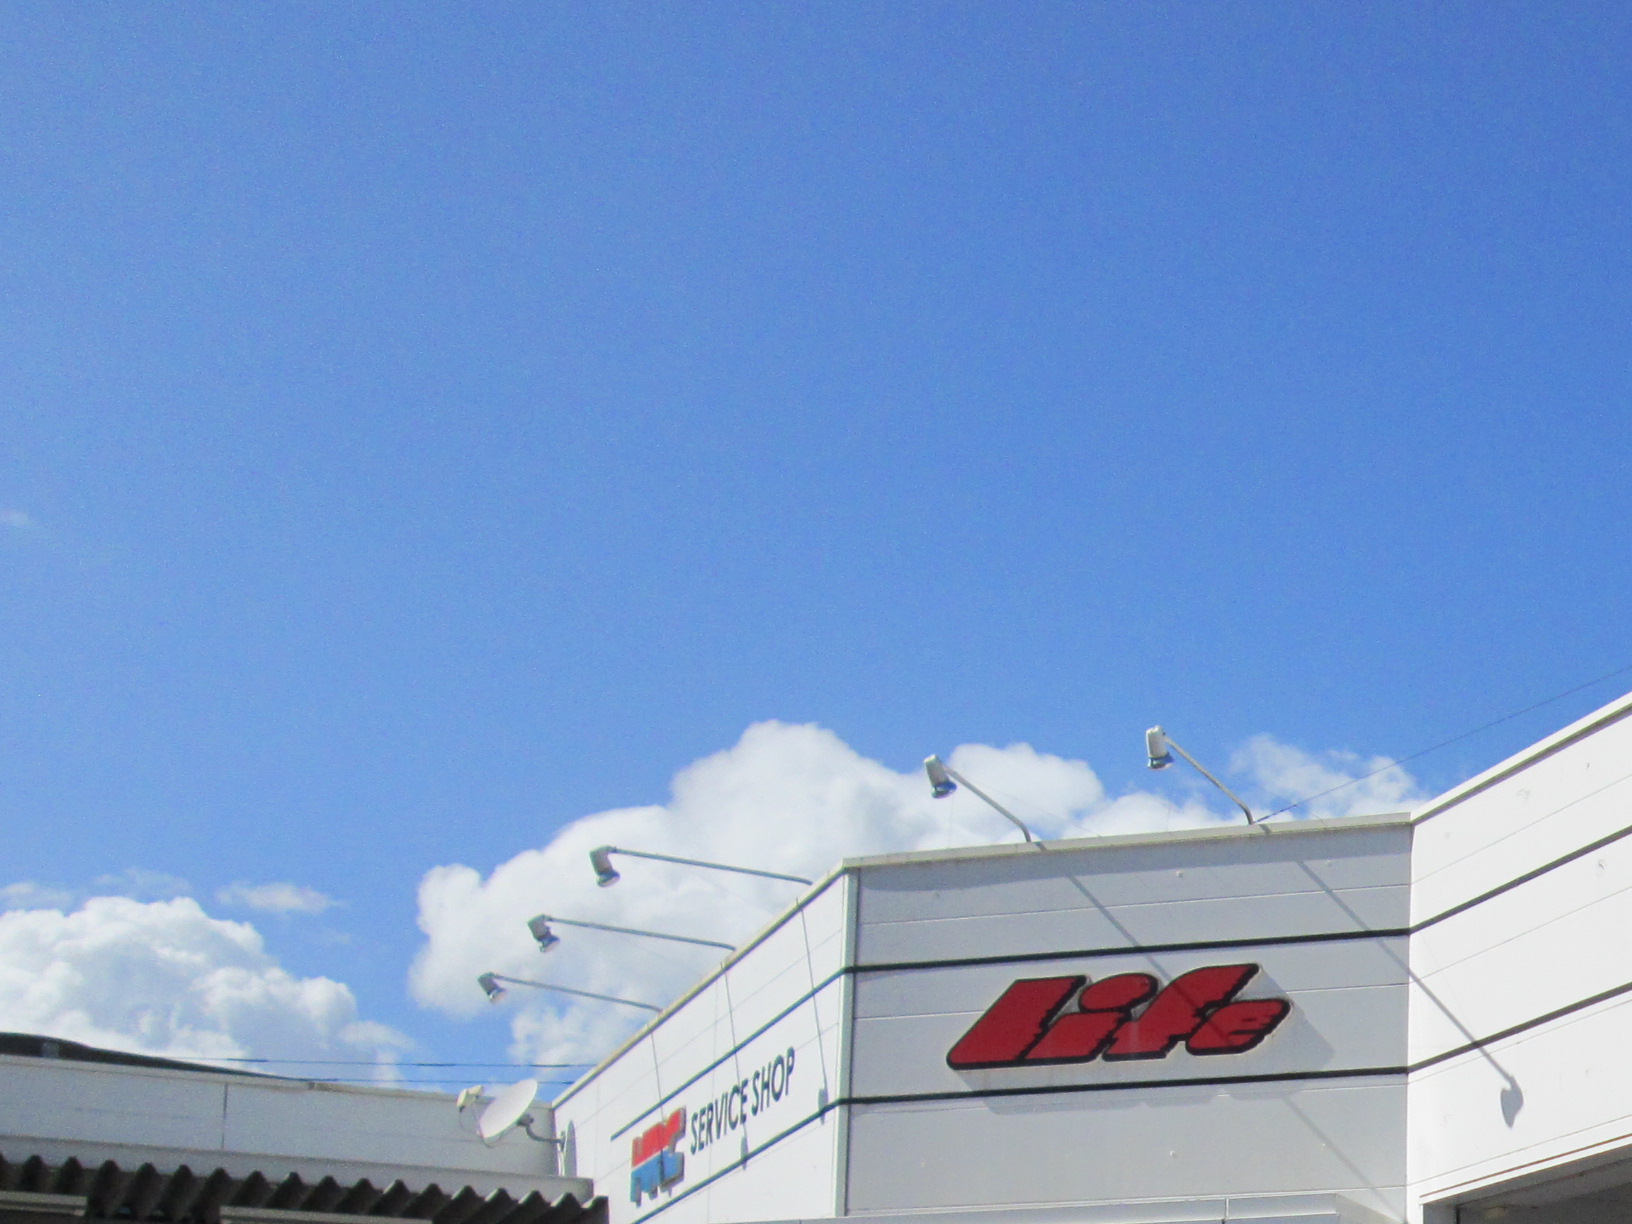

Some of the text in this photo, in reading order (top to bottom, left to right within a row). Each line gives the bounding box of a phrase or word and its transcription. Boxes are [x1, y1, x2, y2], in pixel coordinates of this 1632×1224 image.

[946, 962, 1292, 1070] Life
[690, 1078, 749, 1155] SERVICE
[752, 1046, 796, 1116] SHOP
